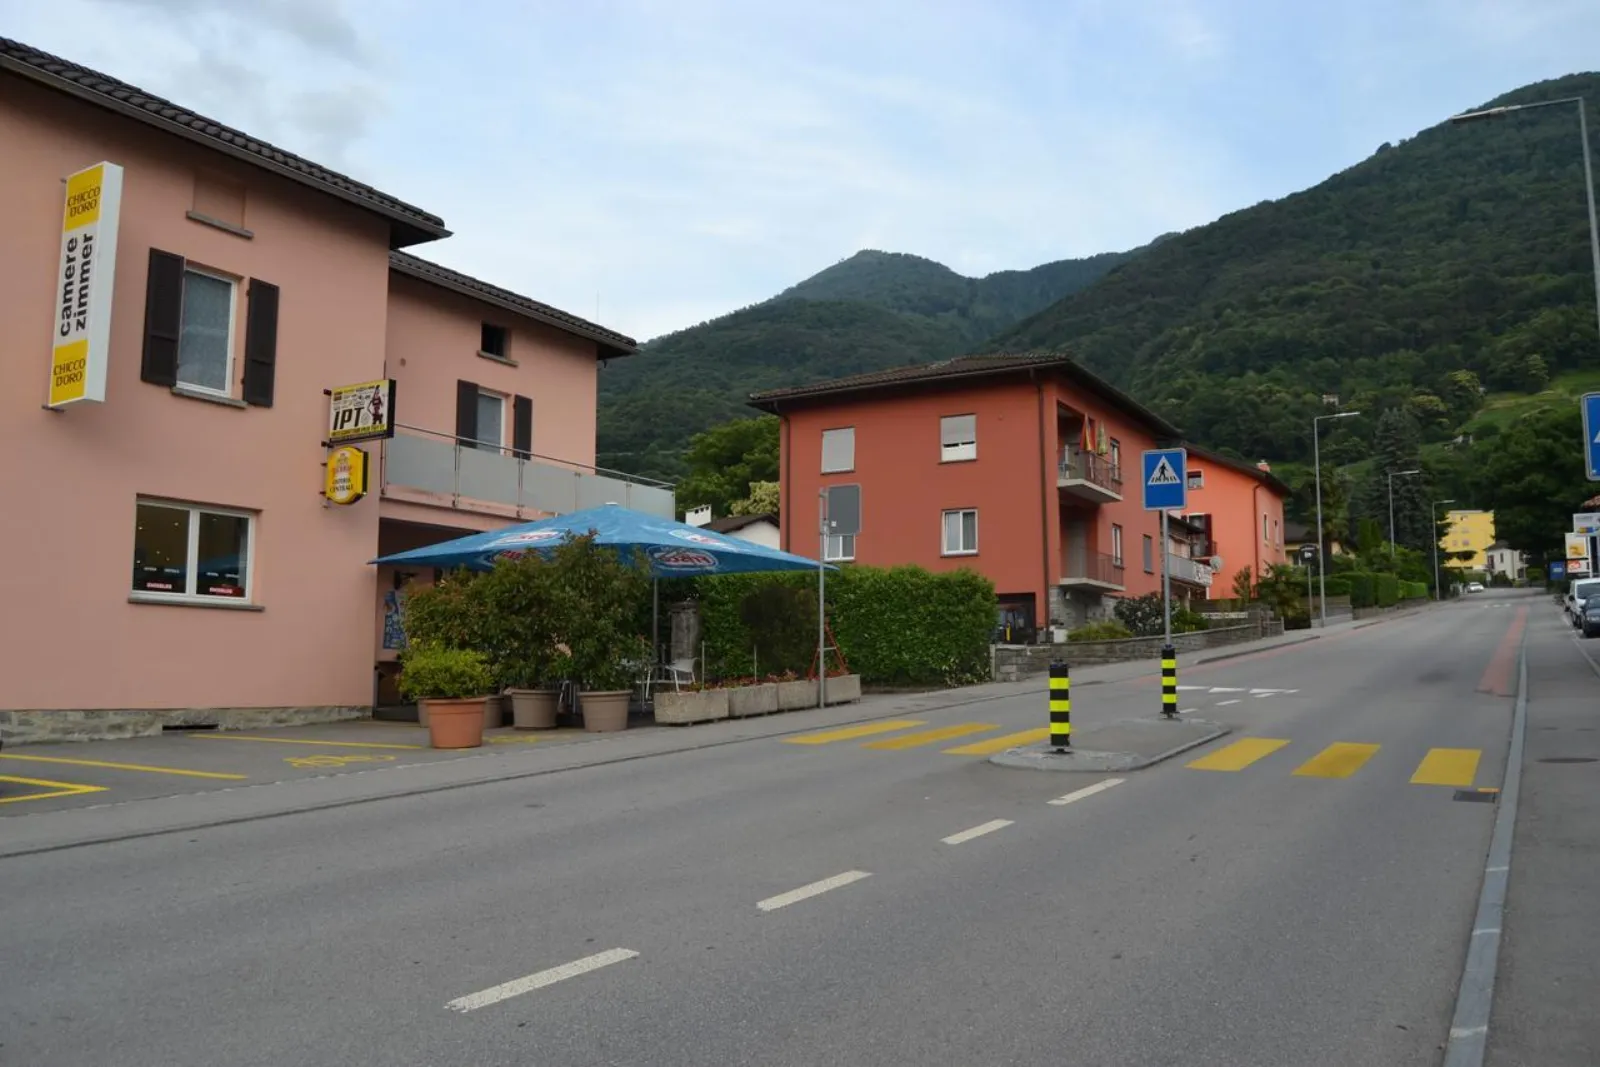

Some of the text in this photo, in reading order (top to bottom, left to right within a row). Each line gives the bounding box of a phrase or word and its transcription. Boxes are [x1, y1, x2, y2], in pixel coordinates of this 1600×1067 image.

[67, 186, 100, 207] CHICCO
[60, 237, 78, 337] camere
[73, 233, 93, 332] zimmer
[54, 358, 86, 376] CHICCO
[333, 406, 365, 431] IPT
